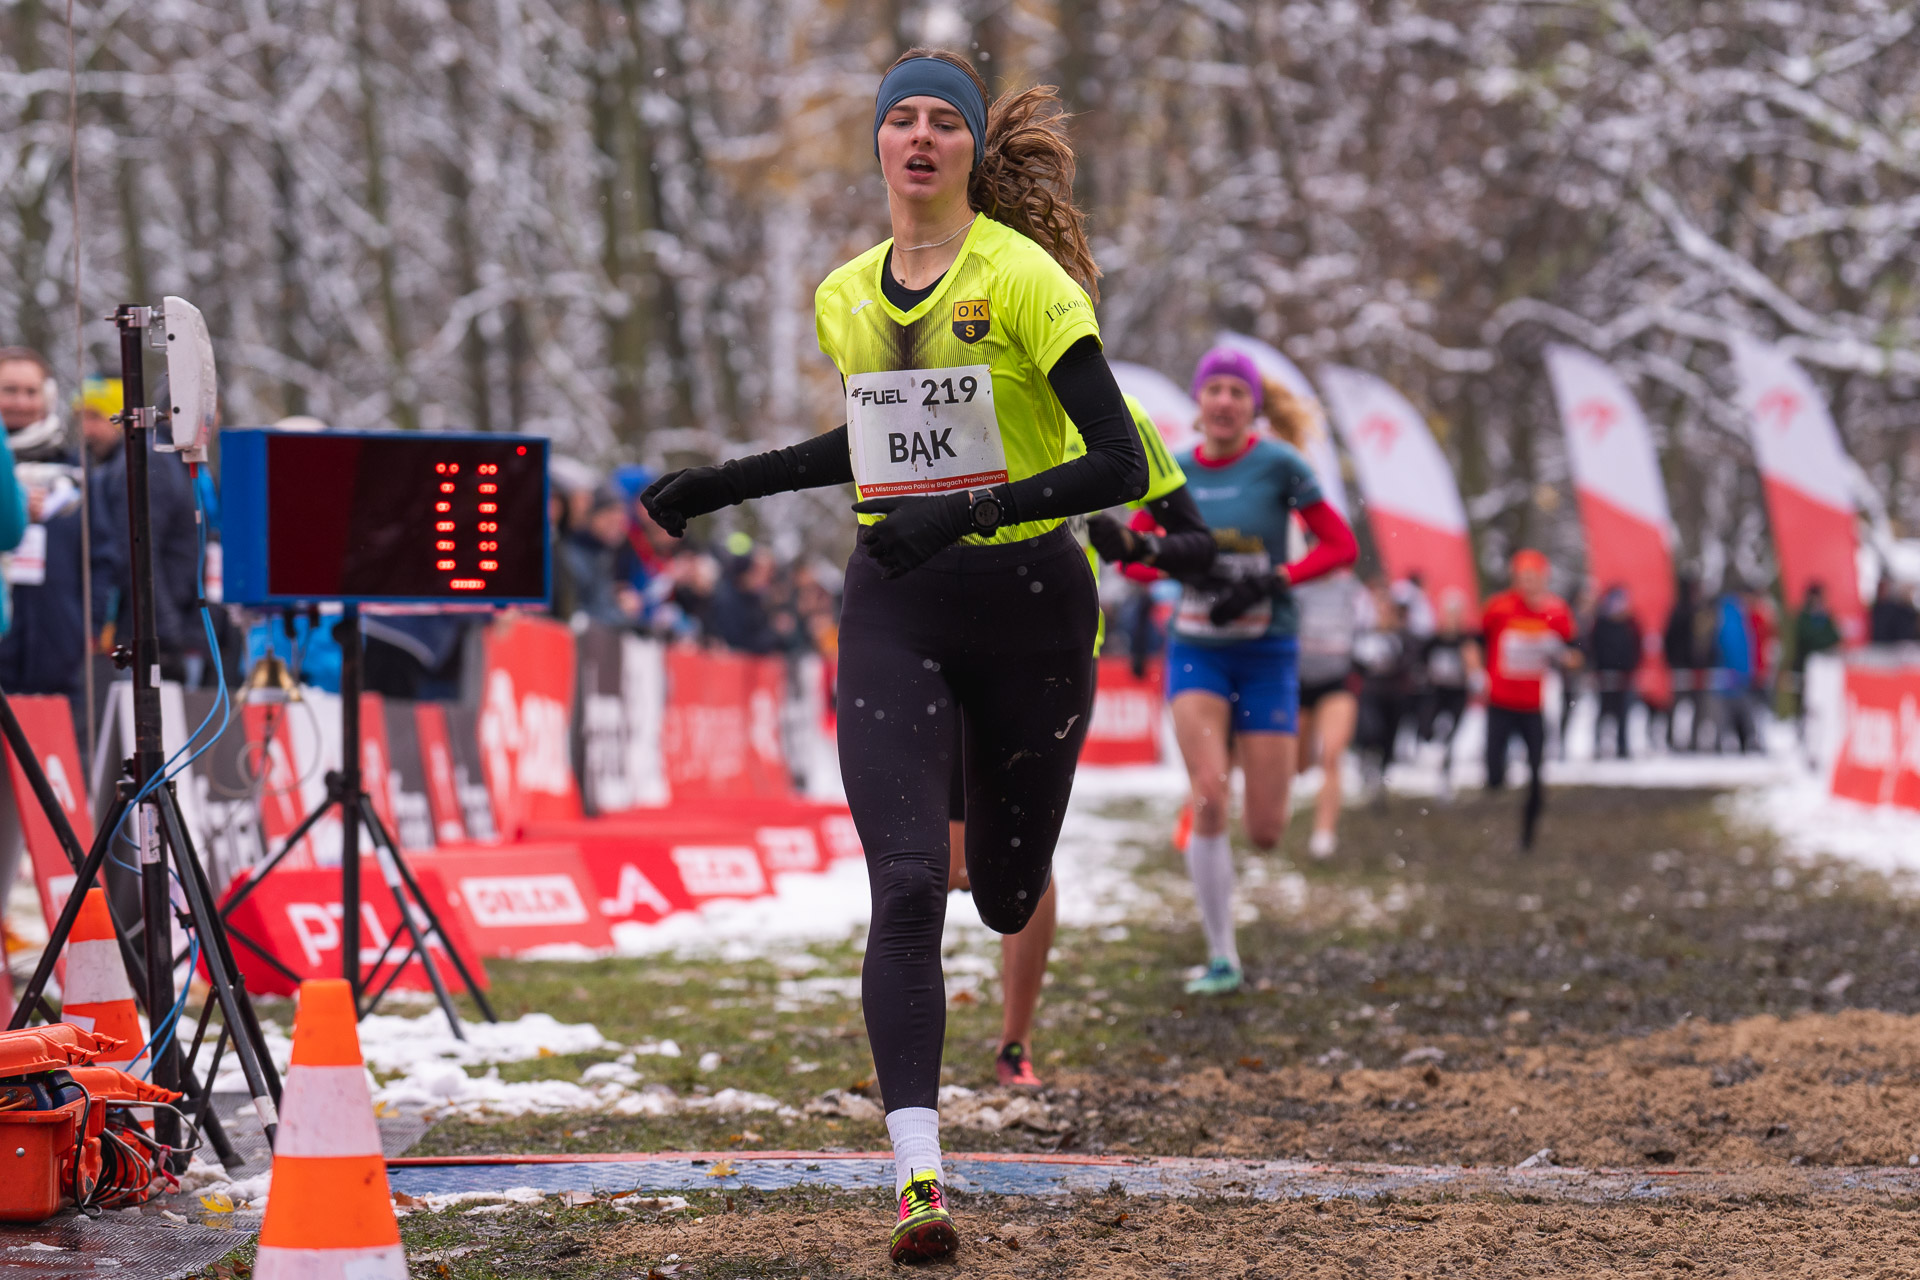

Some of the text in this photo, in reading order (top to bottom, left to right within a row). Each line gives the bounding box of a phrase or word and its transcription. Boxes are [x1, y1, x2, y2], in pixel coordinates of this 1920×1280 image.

[861, 388, 908, 406] FUEL
[921, 375, 978, 406] 219
[888, 427, 957, 467] BĄK
[875, 483, 913, 493] Mistrzostwa
[913, 481, 930, 490] Polski
[936, 477, 963, 488] Biegach
